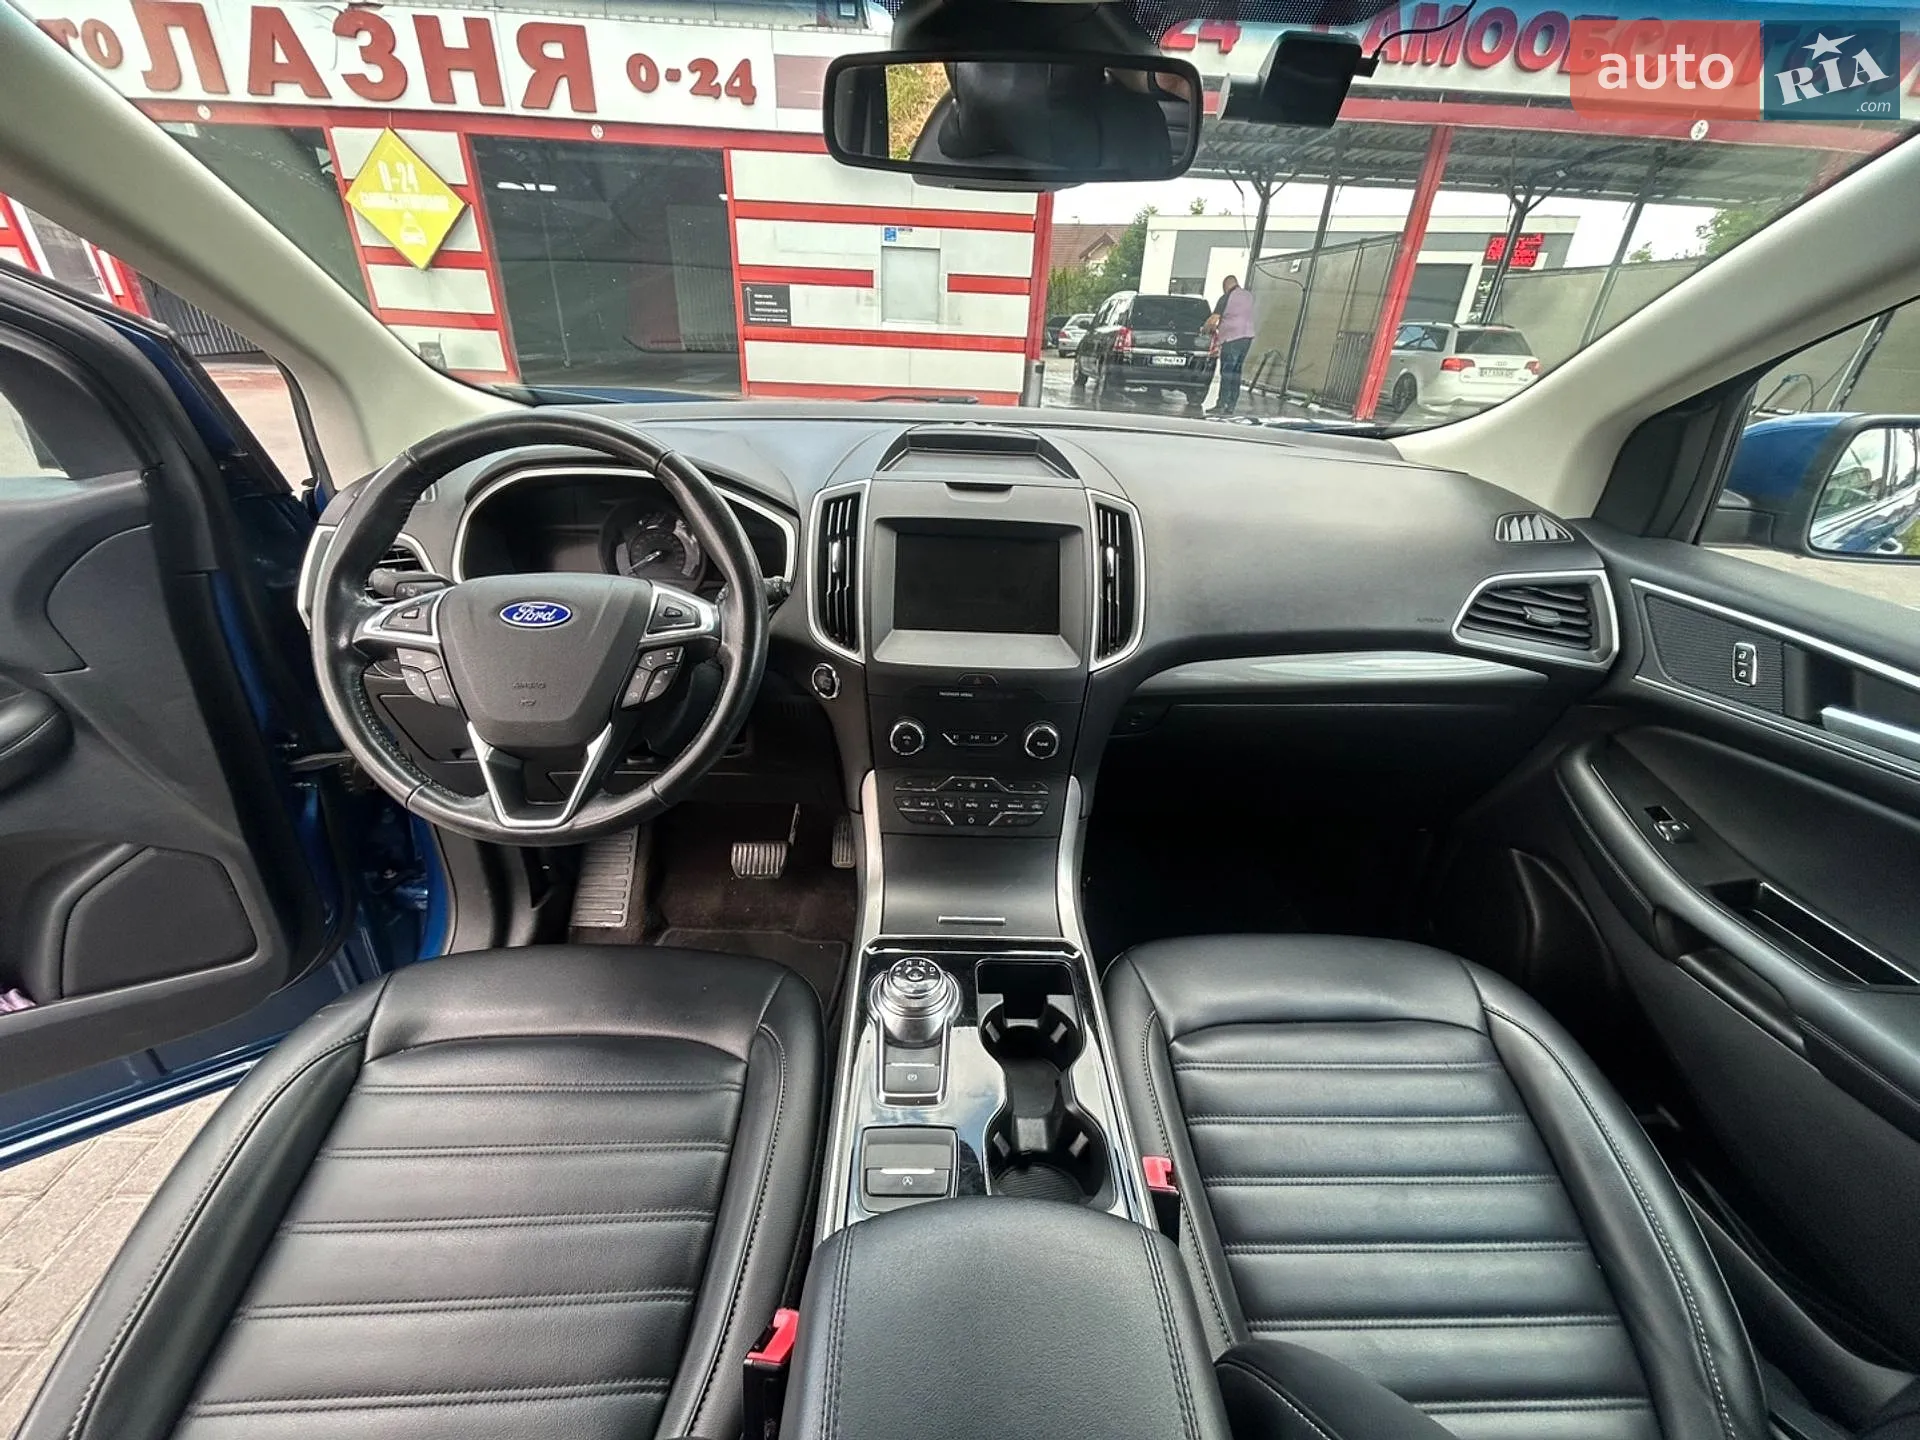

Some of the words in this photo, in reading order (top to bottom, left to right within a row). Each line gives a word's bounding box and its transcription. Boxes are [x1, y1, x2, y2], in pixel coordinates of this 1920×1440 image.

[133, 0, 598, 113] ЛАЗНЯ
[626, 53, 758, 106] 0-24
[512, 603, 558, 621] Ford
